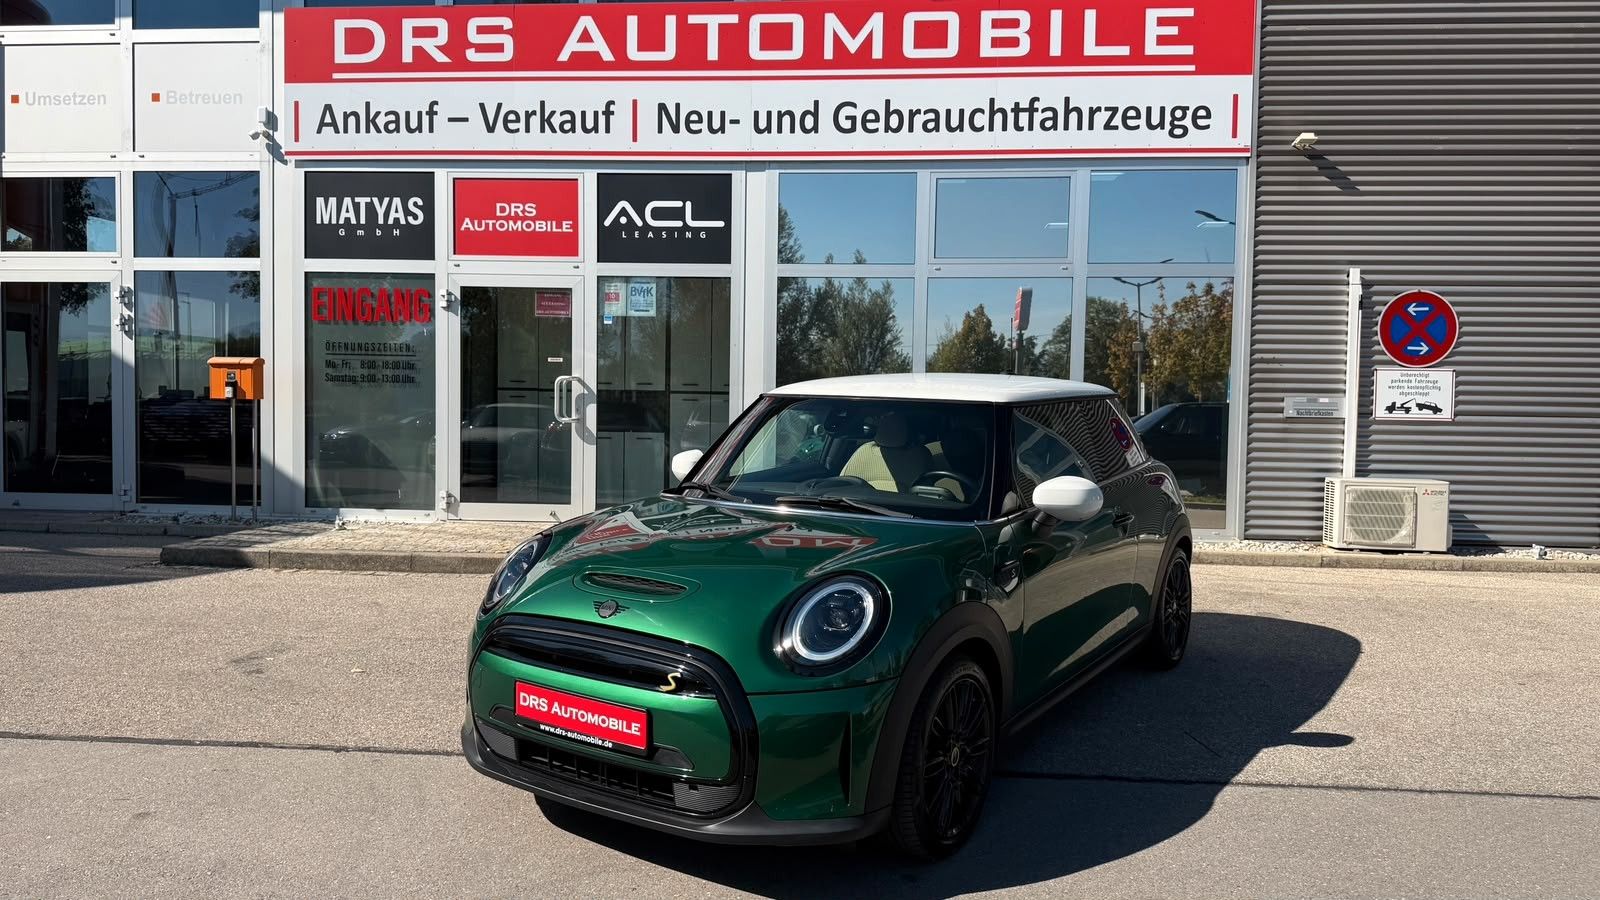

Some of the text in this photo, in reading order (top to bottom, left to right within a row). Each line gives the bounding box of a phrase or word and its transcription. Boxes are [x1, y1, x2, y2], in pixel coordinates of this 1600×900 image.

[333, 7, 1196, 64] DRS AUTOMOBILE
[25, 91, 107, 106] Umsetzen
[166, 90, 243, 105] Betreuen
[316, 100, 439, 135] Ankauf
[478, 100, 616, 135] Verkauf
[657, 102, 741, 135] Neu-
[753, 99, 820, 135] und
[832, 97, 1212, 139] Gebrauchtfahrzeuge
[315, 196, 424, 226] MATYAS
[495, 202, 537, 217] DRS
[603, 200, 725, 228] ACL
[338, 228, 400, 237] GmbH
[460, 217, 573, 233] AUTOMOBILE
[622, 230, 707, 239] LEASING
[312, 287, 431, 323] EINGANG
[325, 340, 415, 353] ÖFFNUNGSZEITEN:
[360, 360, 376, 369] 8:00
[382, 360, 400, 370] 18:00
[519, 692, 641, 736] DRS AUTOMOBILE
[540, 723, 613, 748] www.drs-automobile.de
